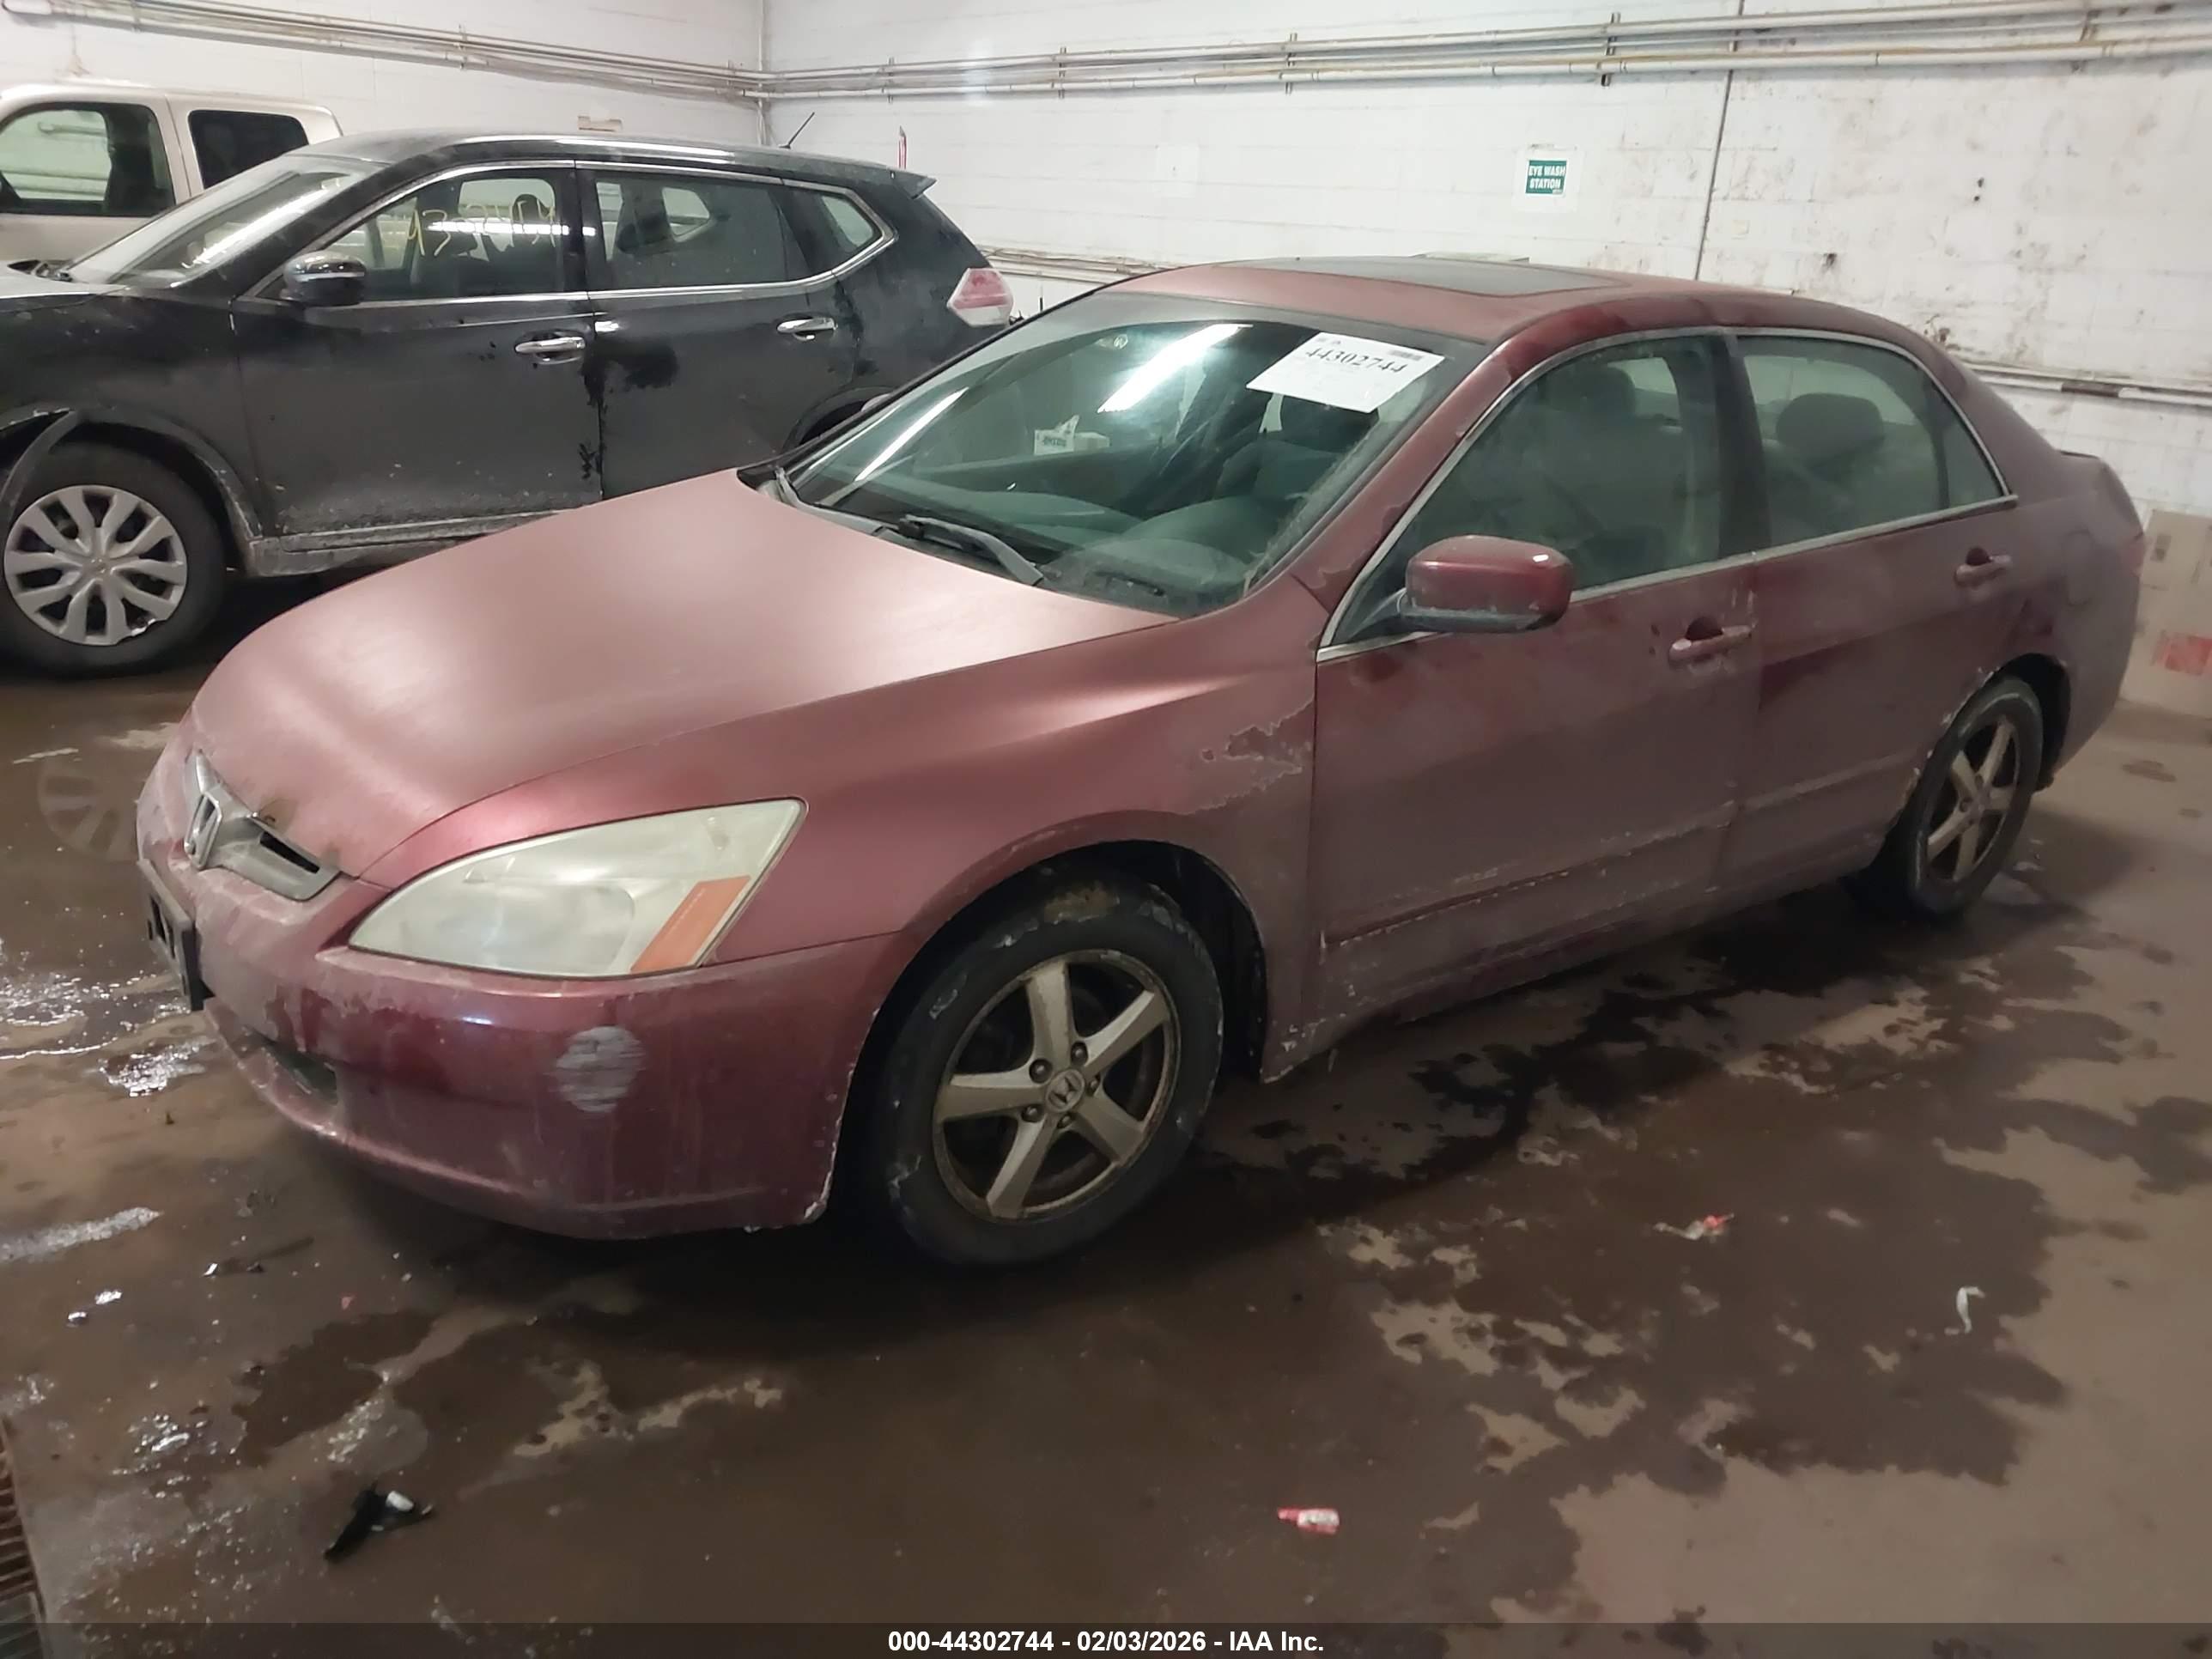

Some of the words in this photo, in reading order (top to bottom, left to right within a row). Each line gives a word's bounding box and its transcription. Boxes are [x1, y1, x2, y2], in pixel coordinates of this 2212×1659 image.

[1528, 166, 1543, 177] EYE
[1544, 166, 1567, 177] WASH
[1529, 178, 1561, 190] STATION
[1305, 347, 1408, 373] 44302744
